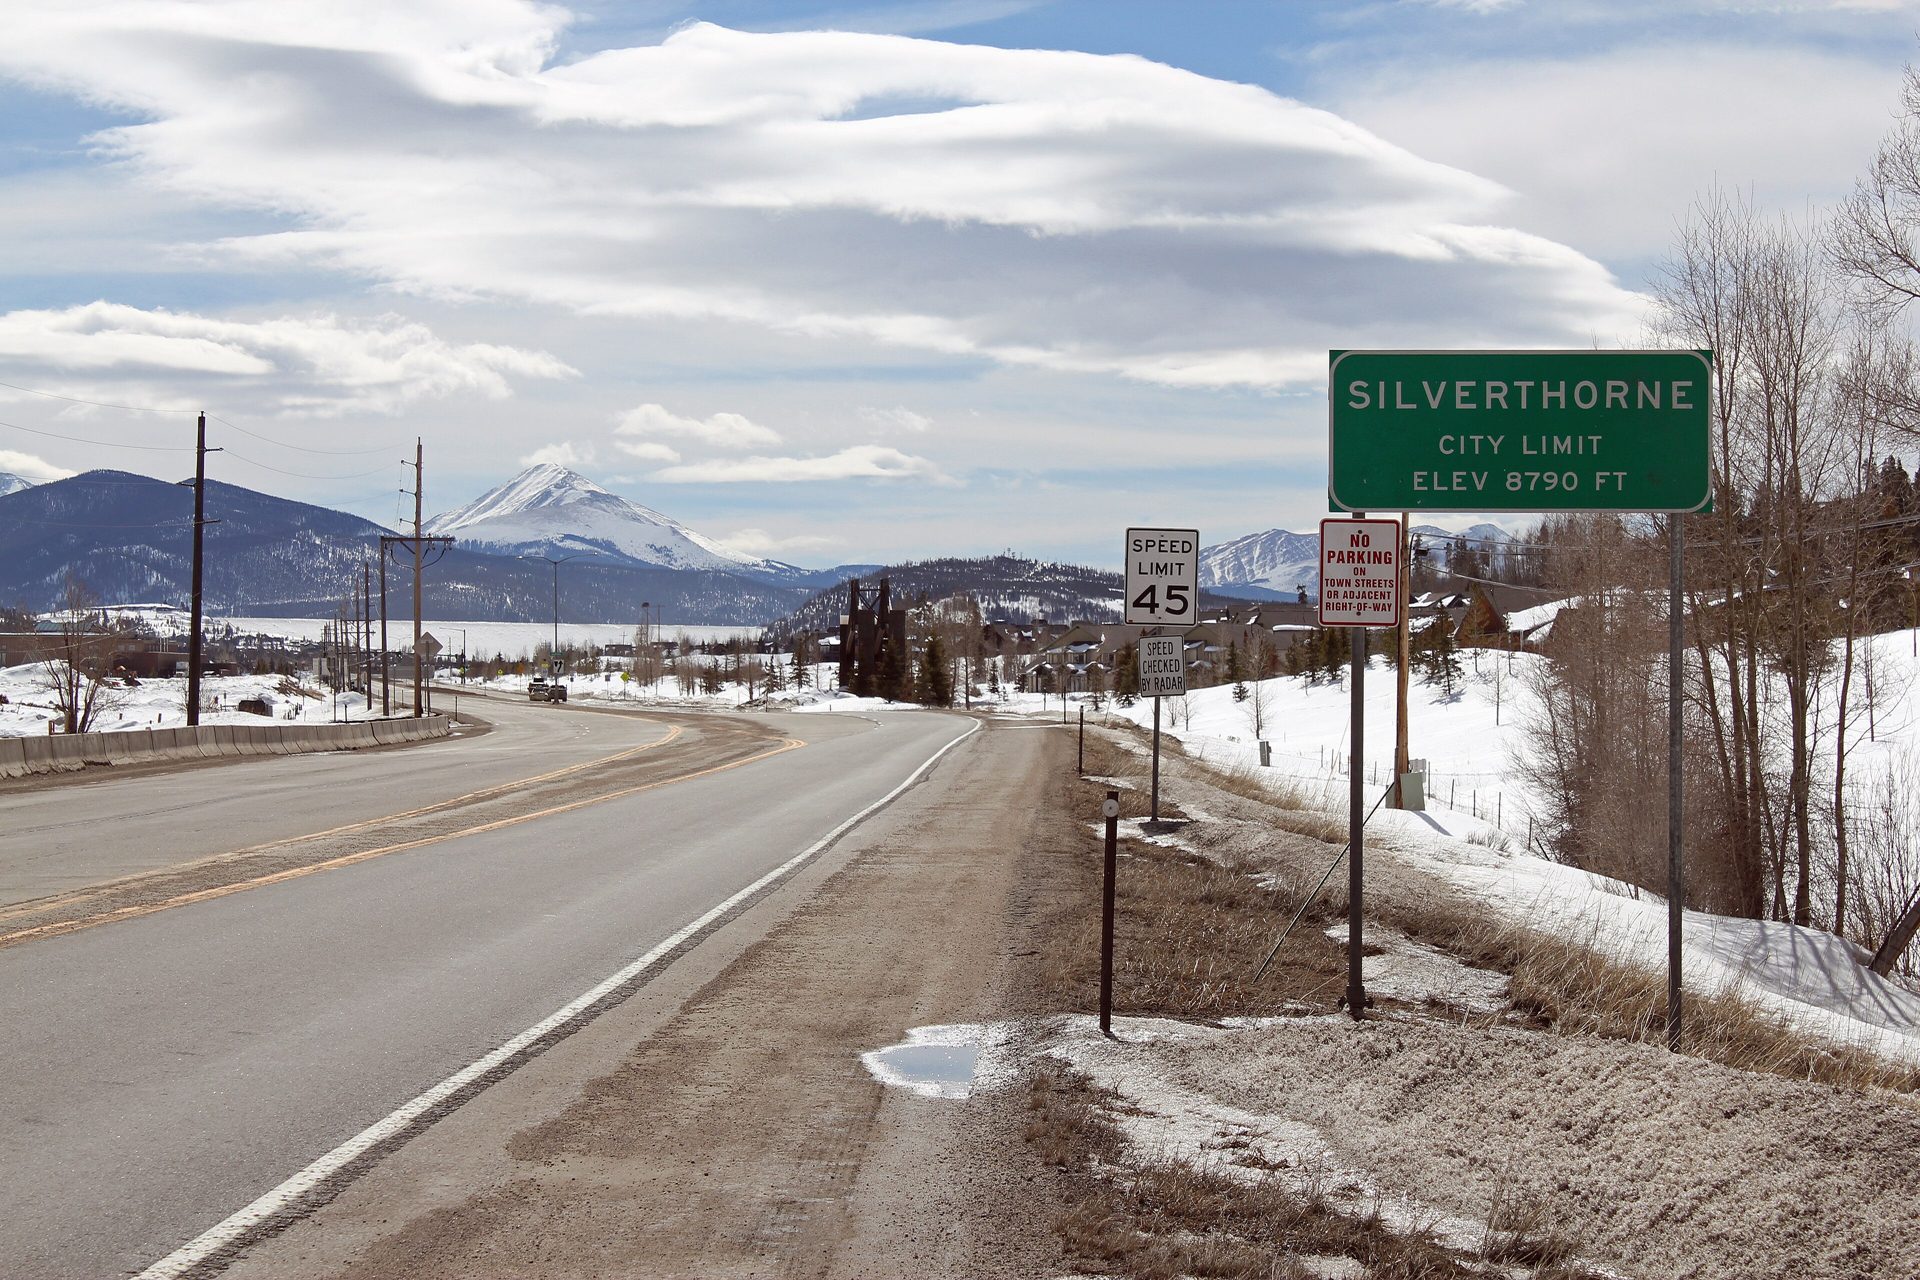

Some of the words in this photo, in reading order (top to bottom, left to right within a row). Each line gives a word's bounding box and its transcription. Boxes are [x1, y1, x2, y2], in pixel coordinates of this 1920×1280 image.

[1348, 380, 1694, 410] SILVERTHORNE
[1439, 435, 1505, 455] CITY
[1522, 435, 1603, 455] LIMIT
[1413, 471, 1489, 491] ELEV
[1505, 471, 1578, 491] 8790
[1595, 471, 1627, 491] FT
[1132, 539, 1193, 554] SPEED
[1350, 534, 1370, 548] NO
[1327, 551, 1393, 565] PARKING
[1138, 561, 1185, 576] LIMIT
[1353, 567, 1366, 576] ON
[1324, 578, 1351, 588] TOWN
[1354, 579, 1394, 588] STREETS
[1132, 584, 1190, 615] 45
[1326, 590, 1340, 600] OR
[1342, 590, 1392, 600] ADJACENT
[1325, 602, 1393, 612] RIGHT-OF-WAY
[1147, 641, 1174, 656] SPEED
[1142, 659, 1180, 674] CHECKED
[1141, 678, 1151, 692] BY
[1154, 677, 1183, 690] RADAR
